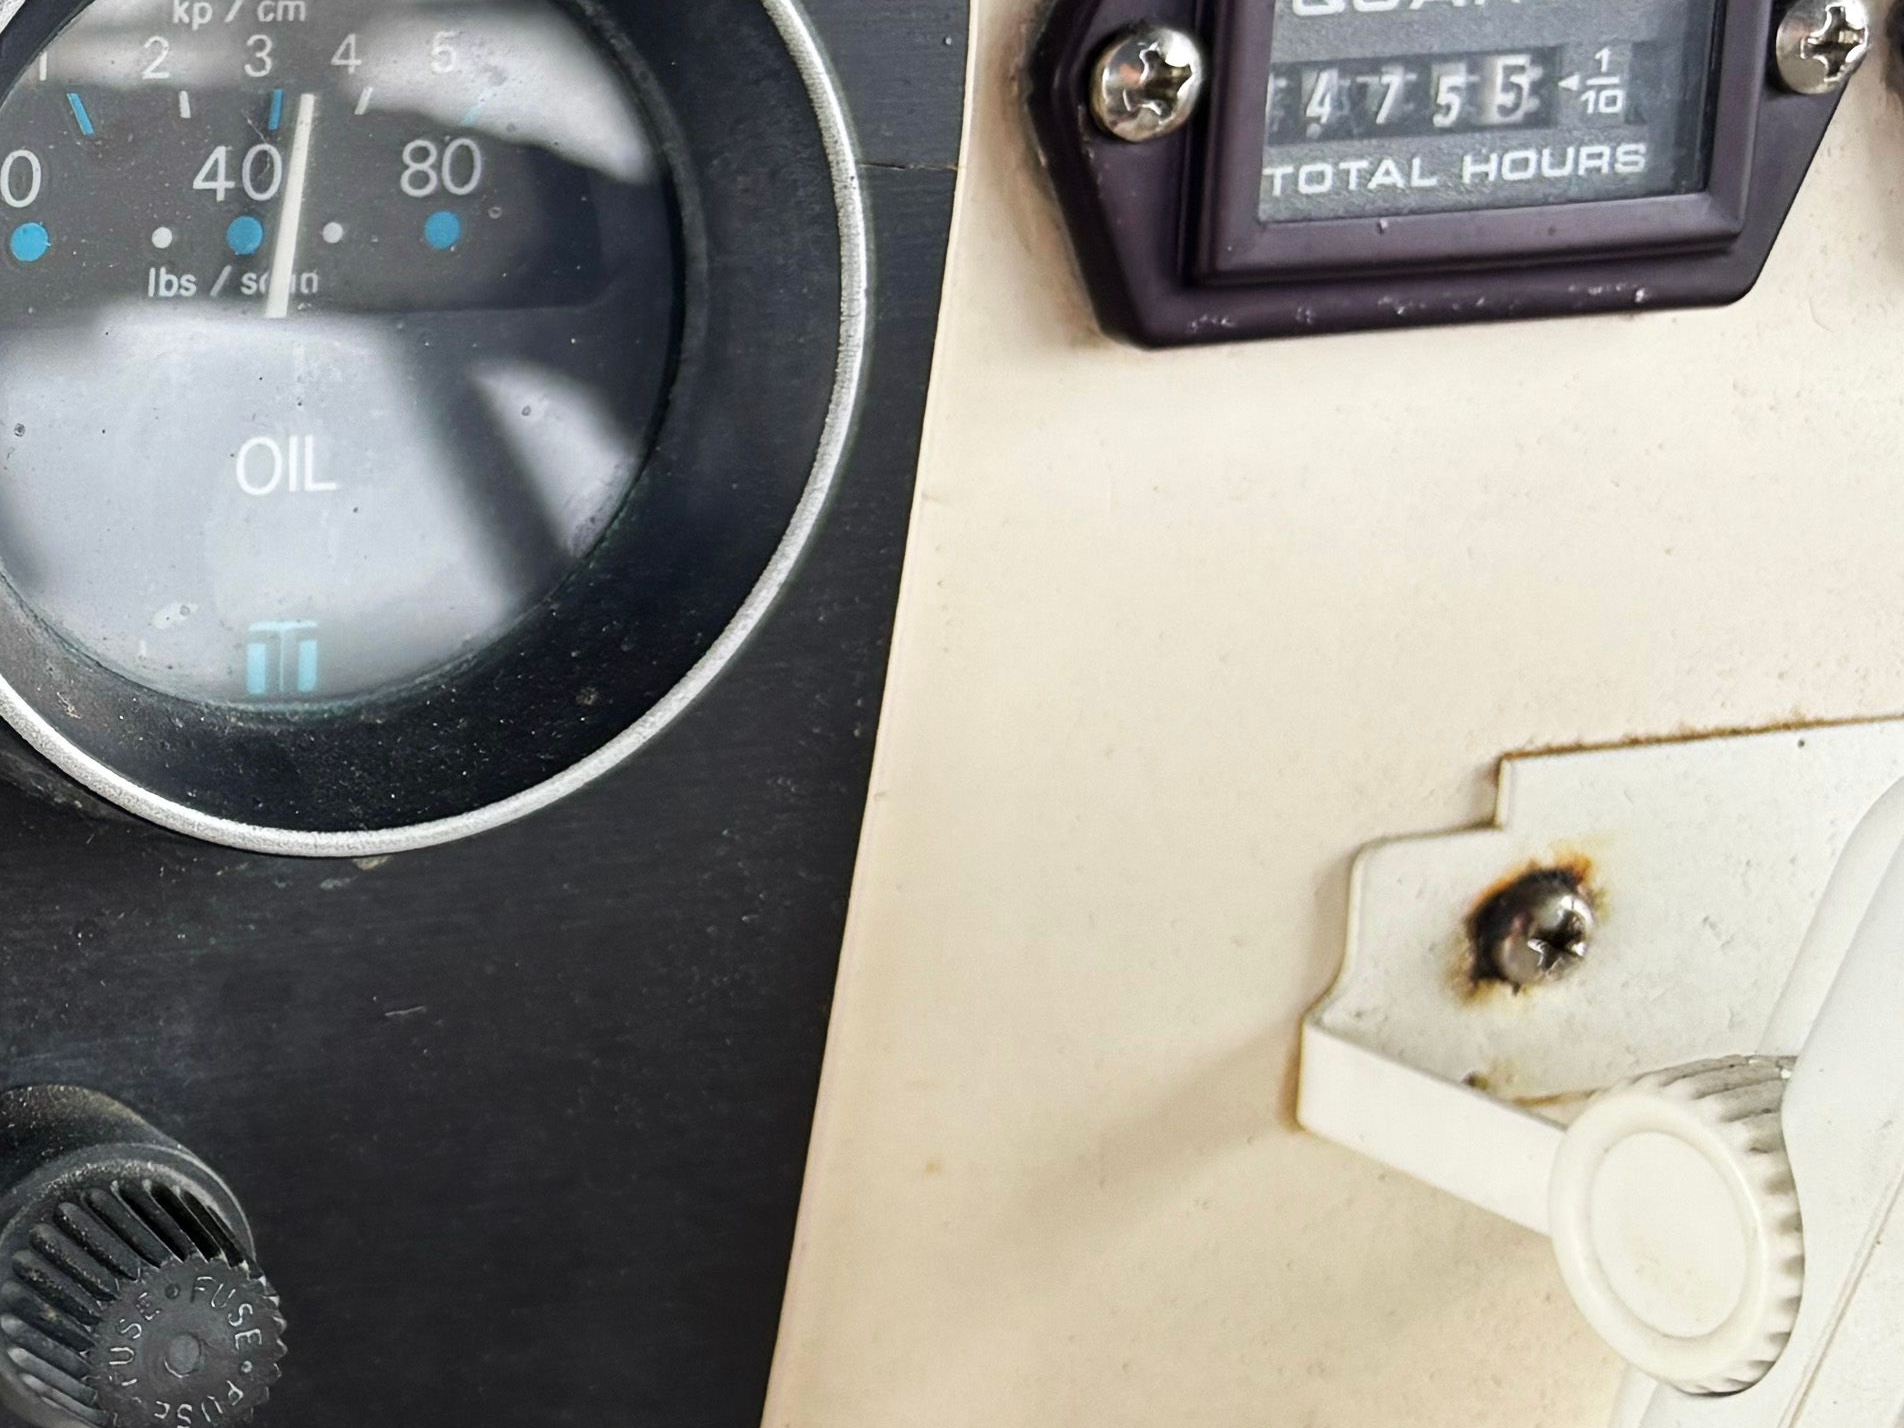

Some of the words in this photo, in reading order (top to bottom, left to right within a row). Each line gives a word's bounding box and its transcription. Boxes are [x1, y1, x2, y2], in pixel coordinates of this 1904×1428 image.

[141, 35, 171, 80] 2
[244, 35, 272, 77] 3
[330, 33, 363, 74] 4
[430, 31, 458, 73] 5
[0, 150, 41, 207] 0
[193, 143, 282, 201] 40
[400, 138, 482, 197] 80
[1262, 157, 1439, 197] TOTAL
[1463, 144, 1646, 184] HOURS
[148, 267, 196, 297] lbs
[237, 435, 338, 495] OIL
[190, 1275, 262, 1351] FUSE
